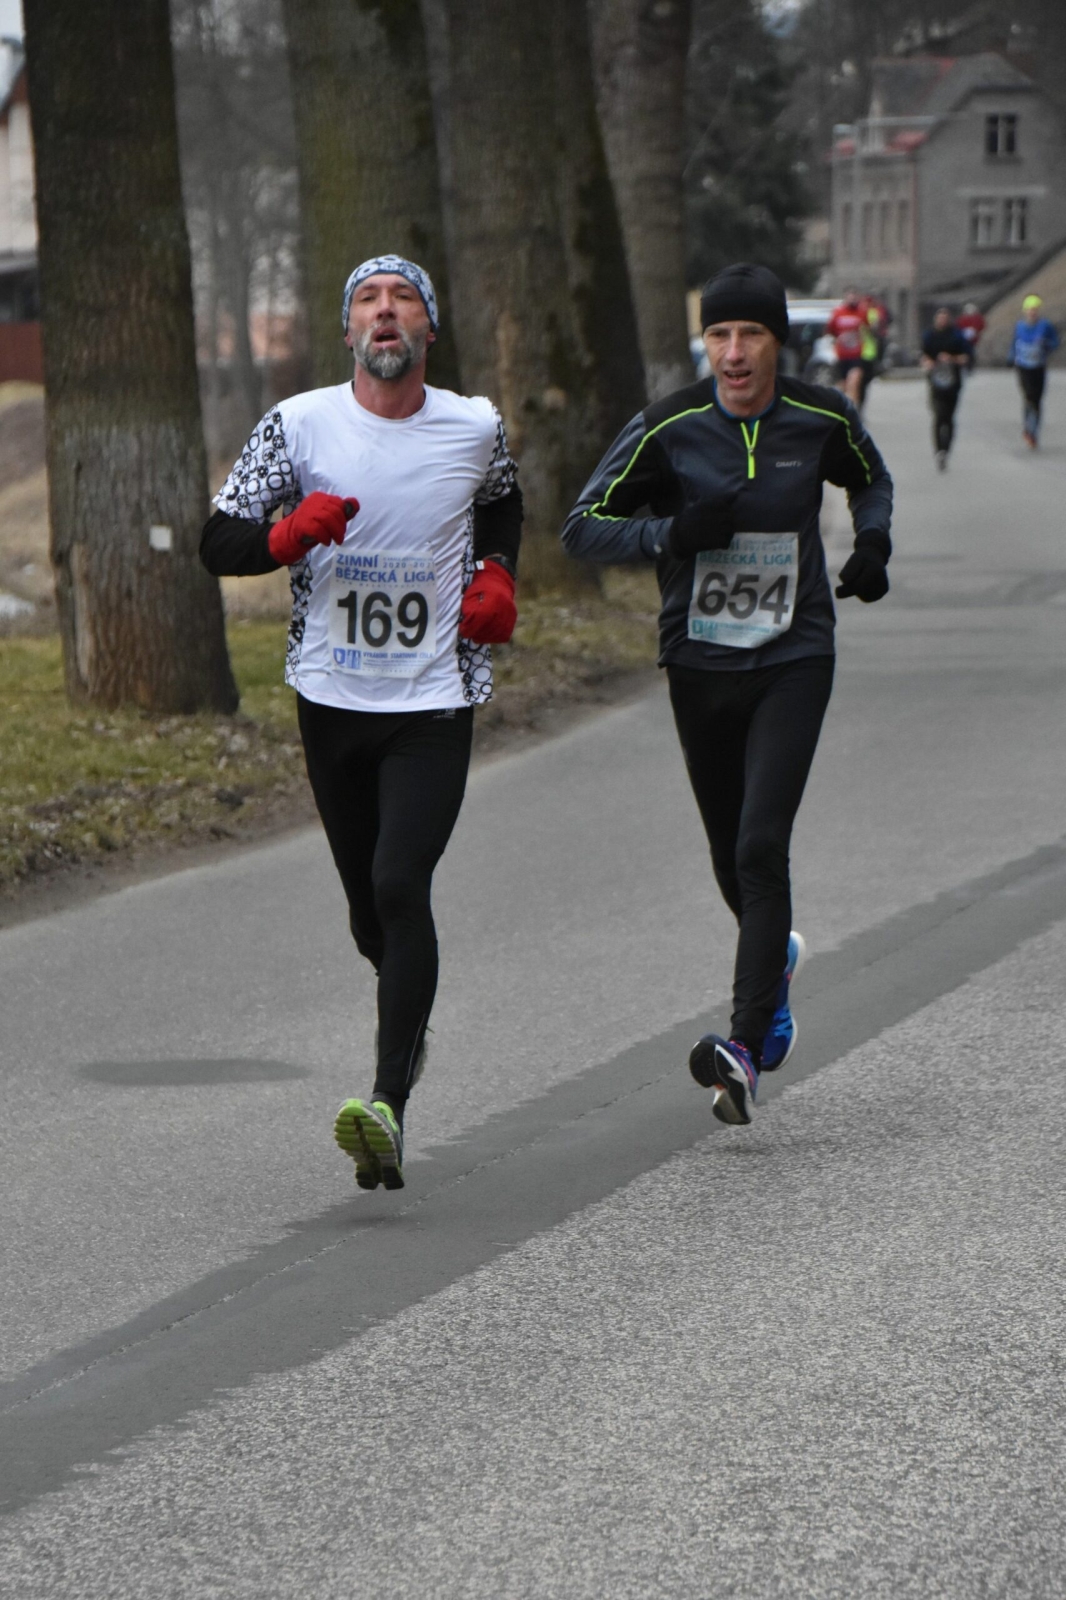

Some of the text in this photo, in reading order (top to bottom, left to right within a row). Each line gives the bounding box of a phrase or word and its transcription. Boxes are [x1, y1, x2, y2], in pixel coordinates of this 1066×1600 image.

[336, 553, 379, 568] ZIMNÍ
[763, 554, 792, 565] LIGA
[335, 567, 397, 583] BĚŽECKÁ
[404, 571, 435, 583] LIGA
[697, 571, 789, 625] 654
[337, 590, 428, 648] 169
